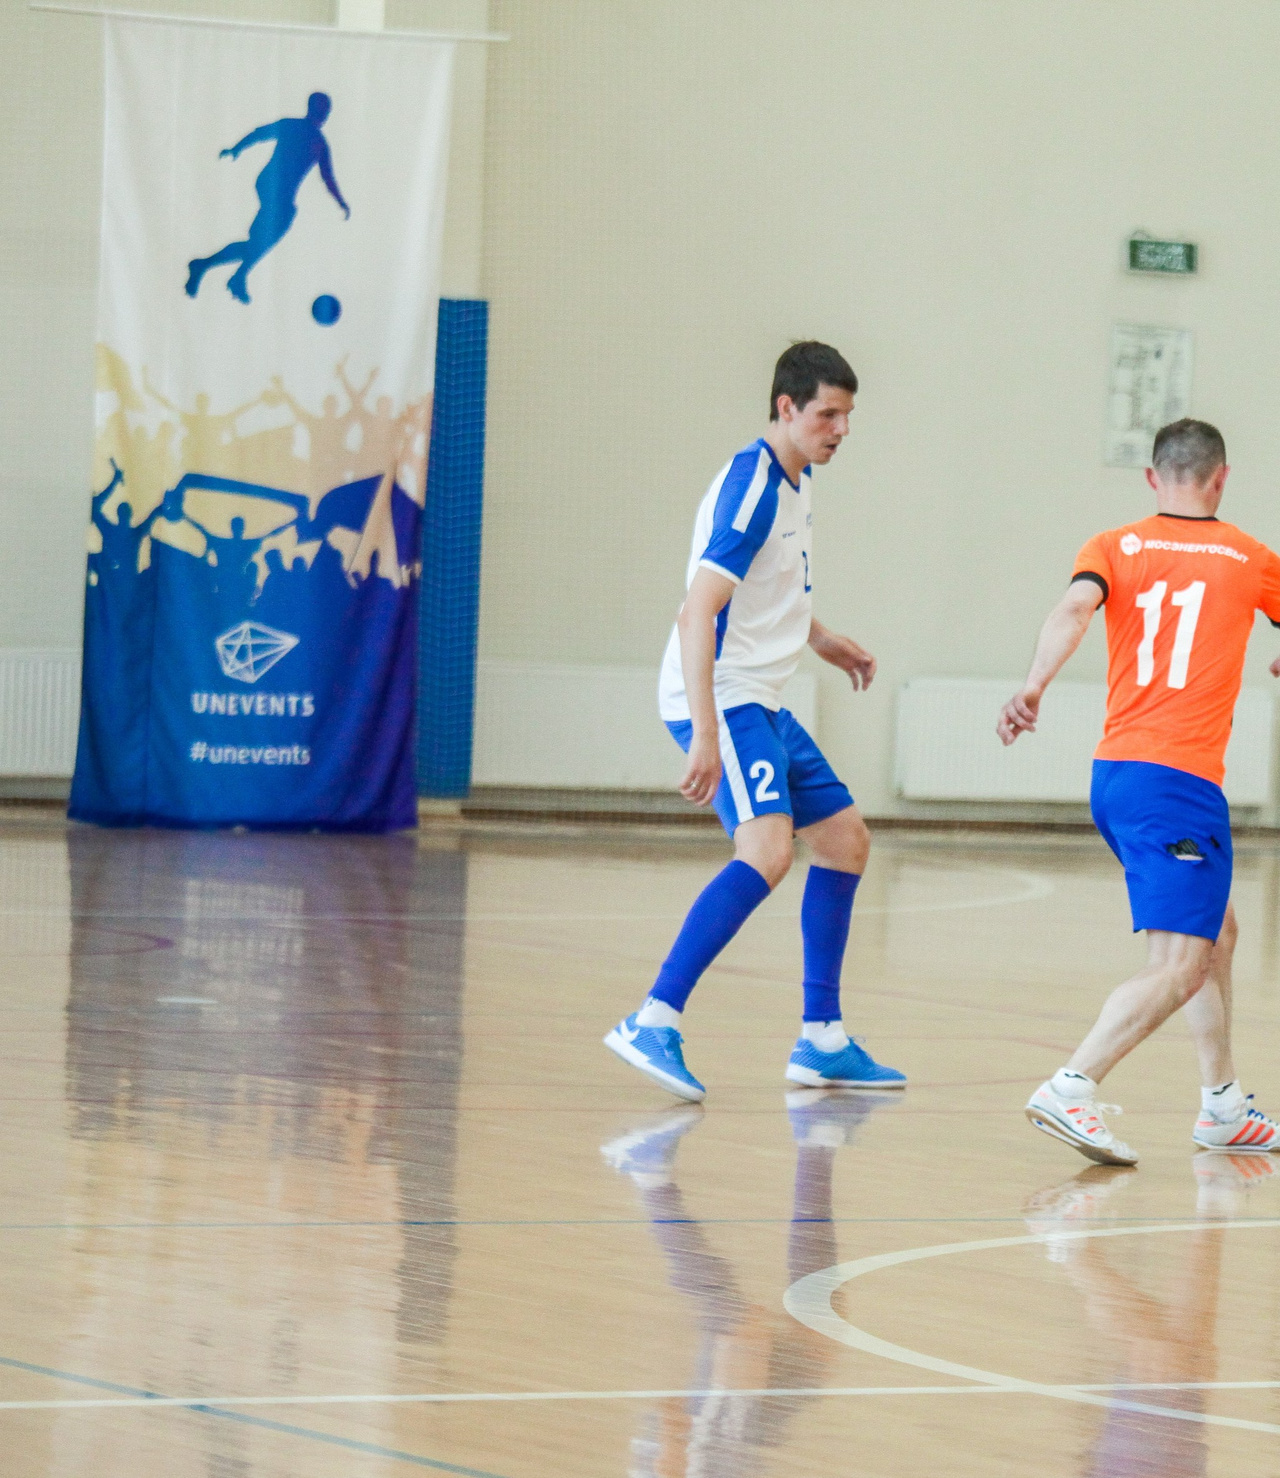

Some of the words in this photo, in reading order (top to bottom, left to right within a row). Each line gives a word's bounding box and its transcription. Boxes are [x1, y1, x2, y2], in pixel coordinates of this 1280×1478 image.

[1144, 539, 1249, 564] МОСЭНЕРГОСБЫТ
[1135, 580, 1206, 690] 11
[191, 692, 315, 718] UNEVENTS
[189, 741, 311, 765] #unevents
[749, 759, 780, 803] 2
